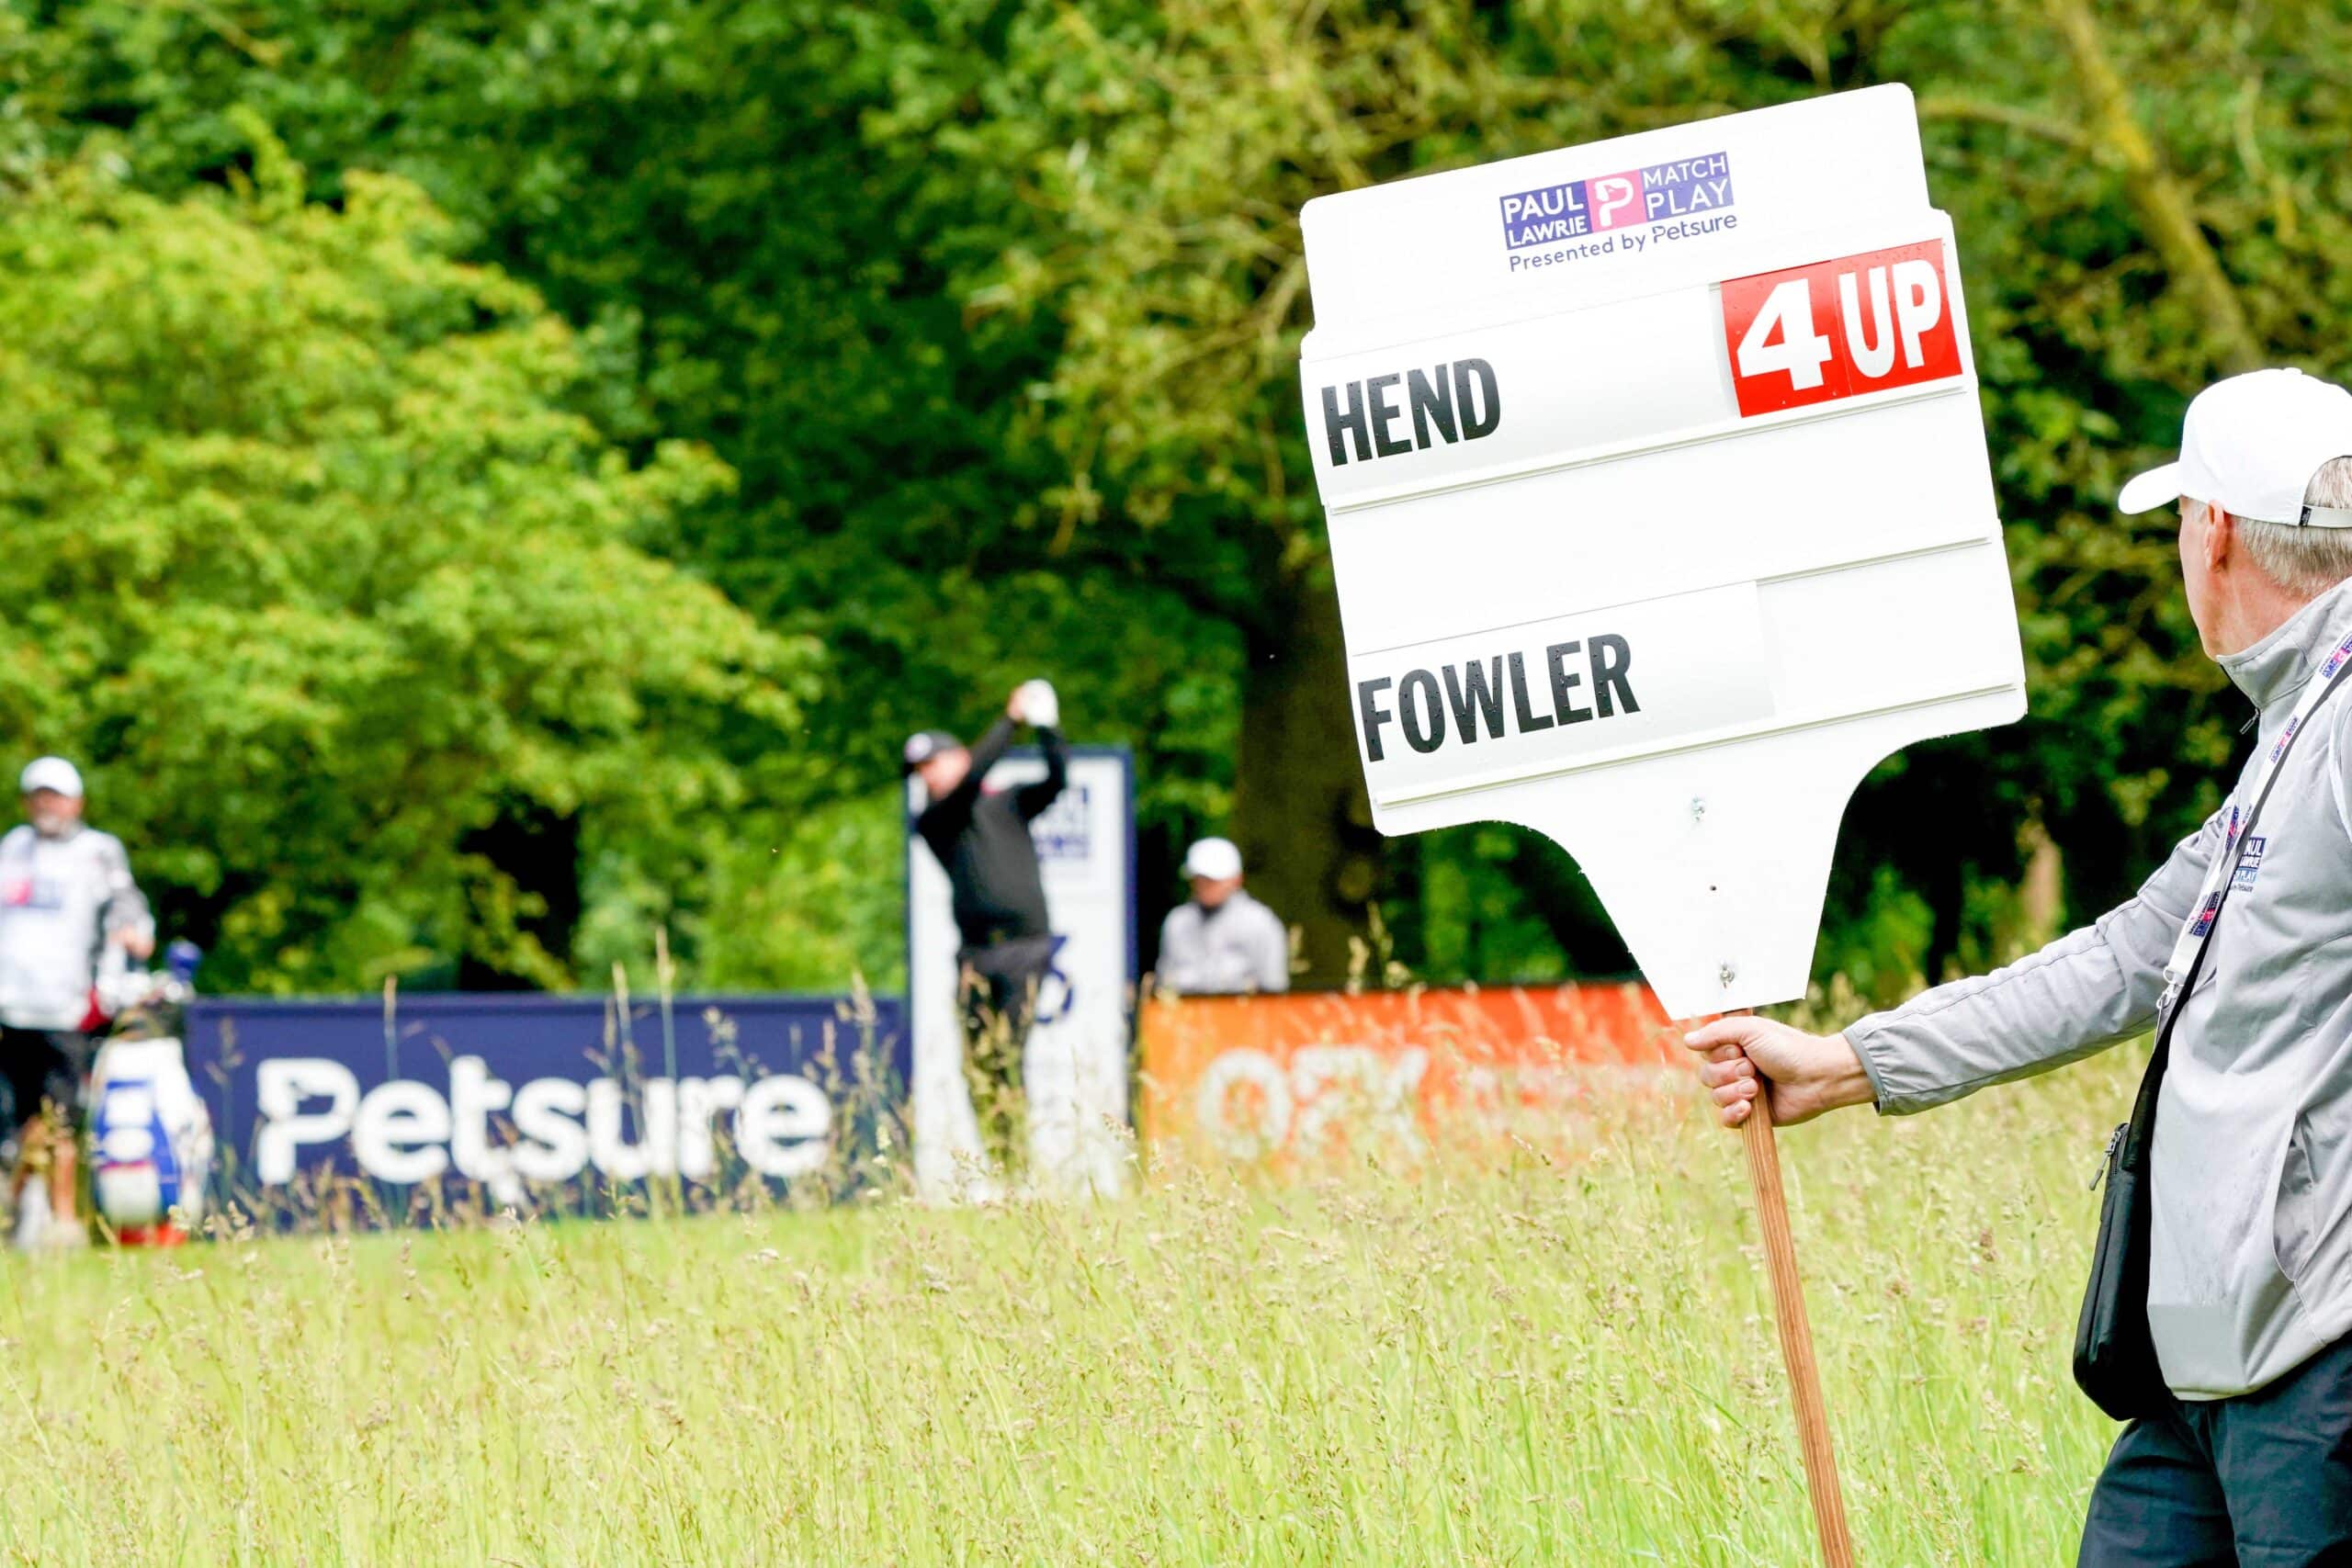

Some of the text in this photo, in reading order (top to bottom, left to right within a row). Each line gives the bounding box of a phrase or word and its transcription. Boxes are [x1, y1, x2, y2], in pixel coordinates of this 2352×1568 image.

[1642, 155, 1726, 189] MATCH
[1645, 178, 1728, 219] PLAY
[1503, 186, 1584, 223] PAUL
[1508, 216, 1588, 247] LAWRIE
[1510, 214, 1737, 272] Presented by Petsure
[1736, 259, 1942, 391] 4 UP
[1321, 357, 1501, 467] HEND
[1357, 633, 1642, 762] FOWLER
[256, 1055, 831, 1186] Petsure
